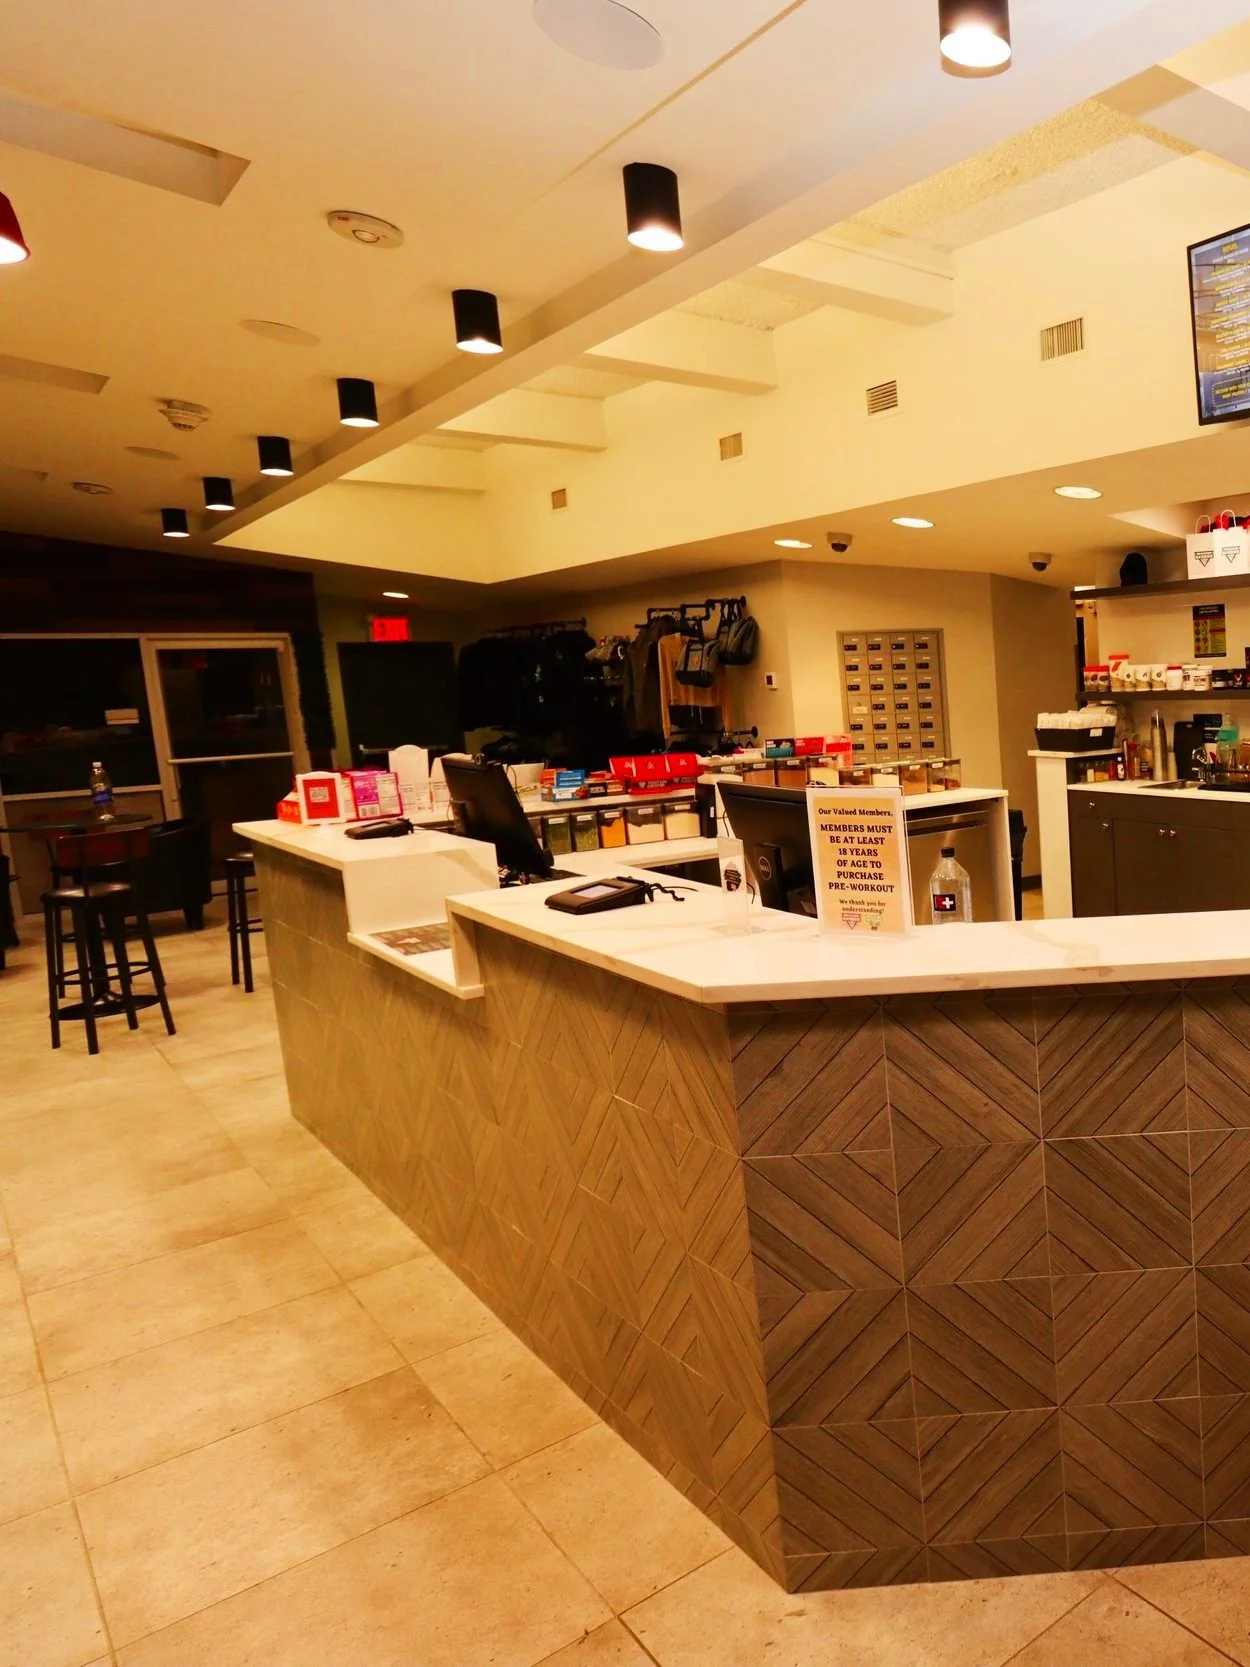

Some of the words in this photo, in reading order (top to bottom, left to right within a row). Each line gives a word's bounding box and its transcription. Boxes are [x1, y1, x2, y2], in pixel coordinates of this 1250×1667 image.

[818, 807, 831, 815] Our
[820, 823, 865, 833] MEMBERS
[867, 825, 893, 834] MUST
[829, 835, 841, 844] BE
[843, 836, 855, 844] AT
[857, 836, 885, 845] LEAST
[838, 847, 848, 856] 18
[849, 848, 878, 857] YEARS
[837, 859, 848, 867] OF
[850, 860, 868, 868] AGE
[870, 860, 882, 869] TO
[836, 870, 885, 881] PURCHASE
[828, 882, 895, 893] PRE-WORKOUT
